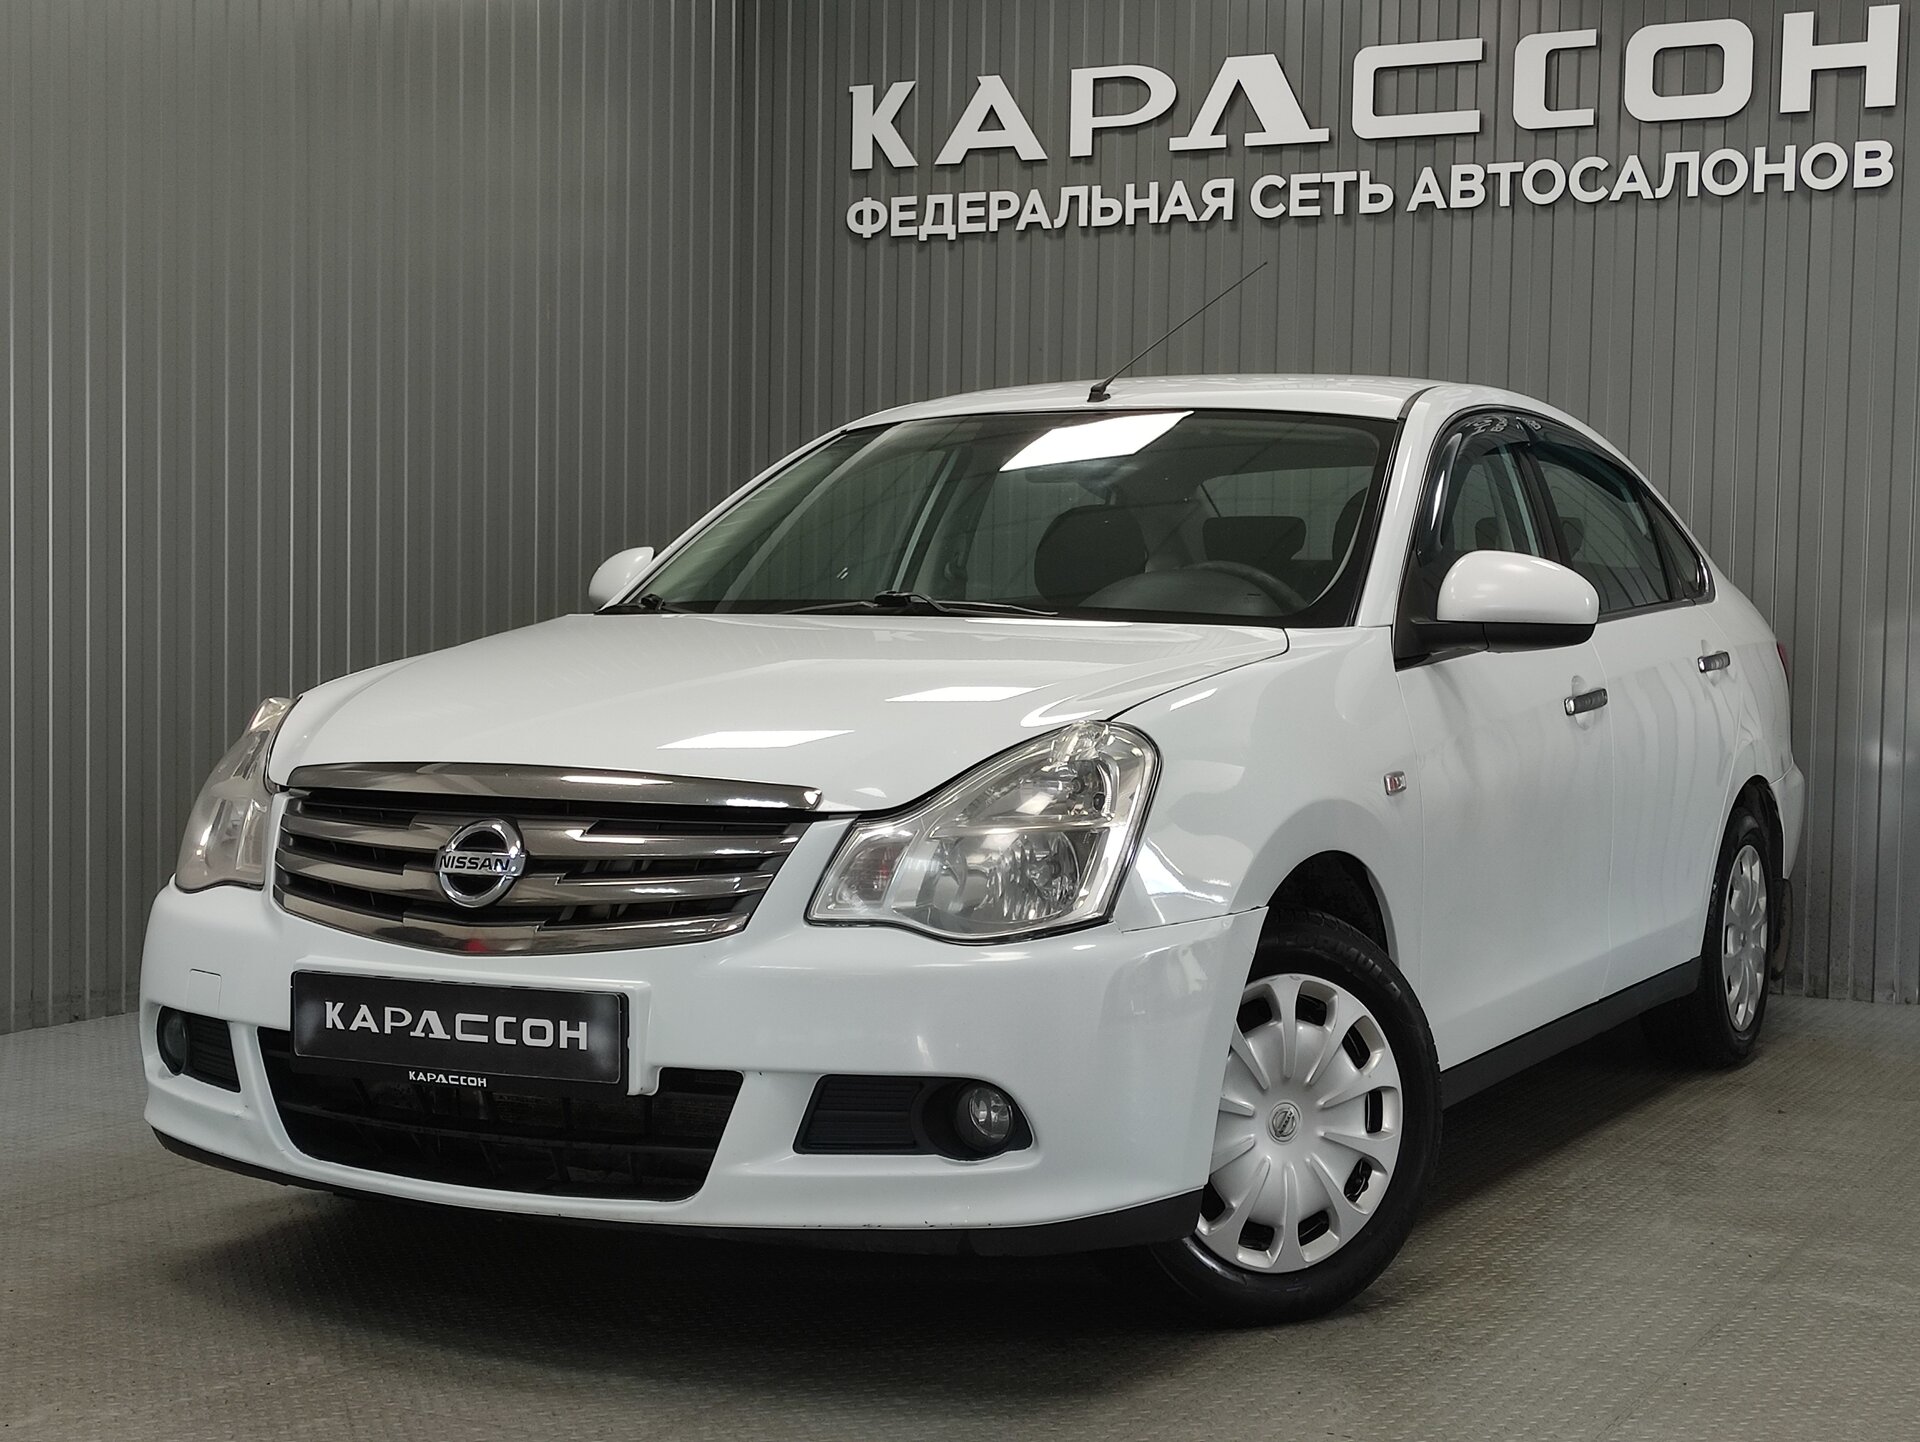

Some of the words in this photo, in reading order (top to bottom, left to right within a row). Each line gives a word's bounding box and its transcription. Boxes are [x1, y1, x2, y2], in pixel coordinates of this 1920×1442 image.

[847, 179, 1234, 240] ФЕДЕРАЛЬНАЯ
[1251, 171, 1394, 218] СЕТЬ
[1407, 141, 1894, 211] АВТОСАЛОНОВ
[440, 855, 510, 871] NISSAN
